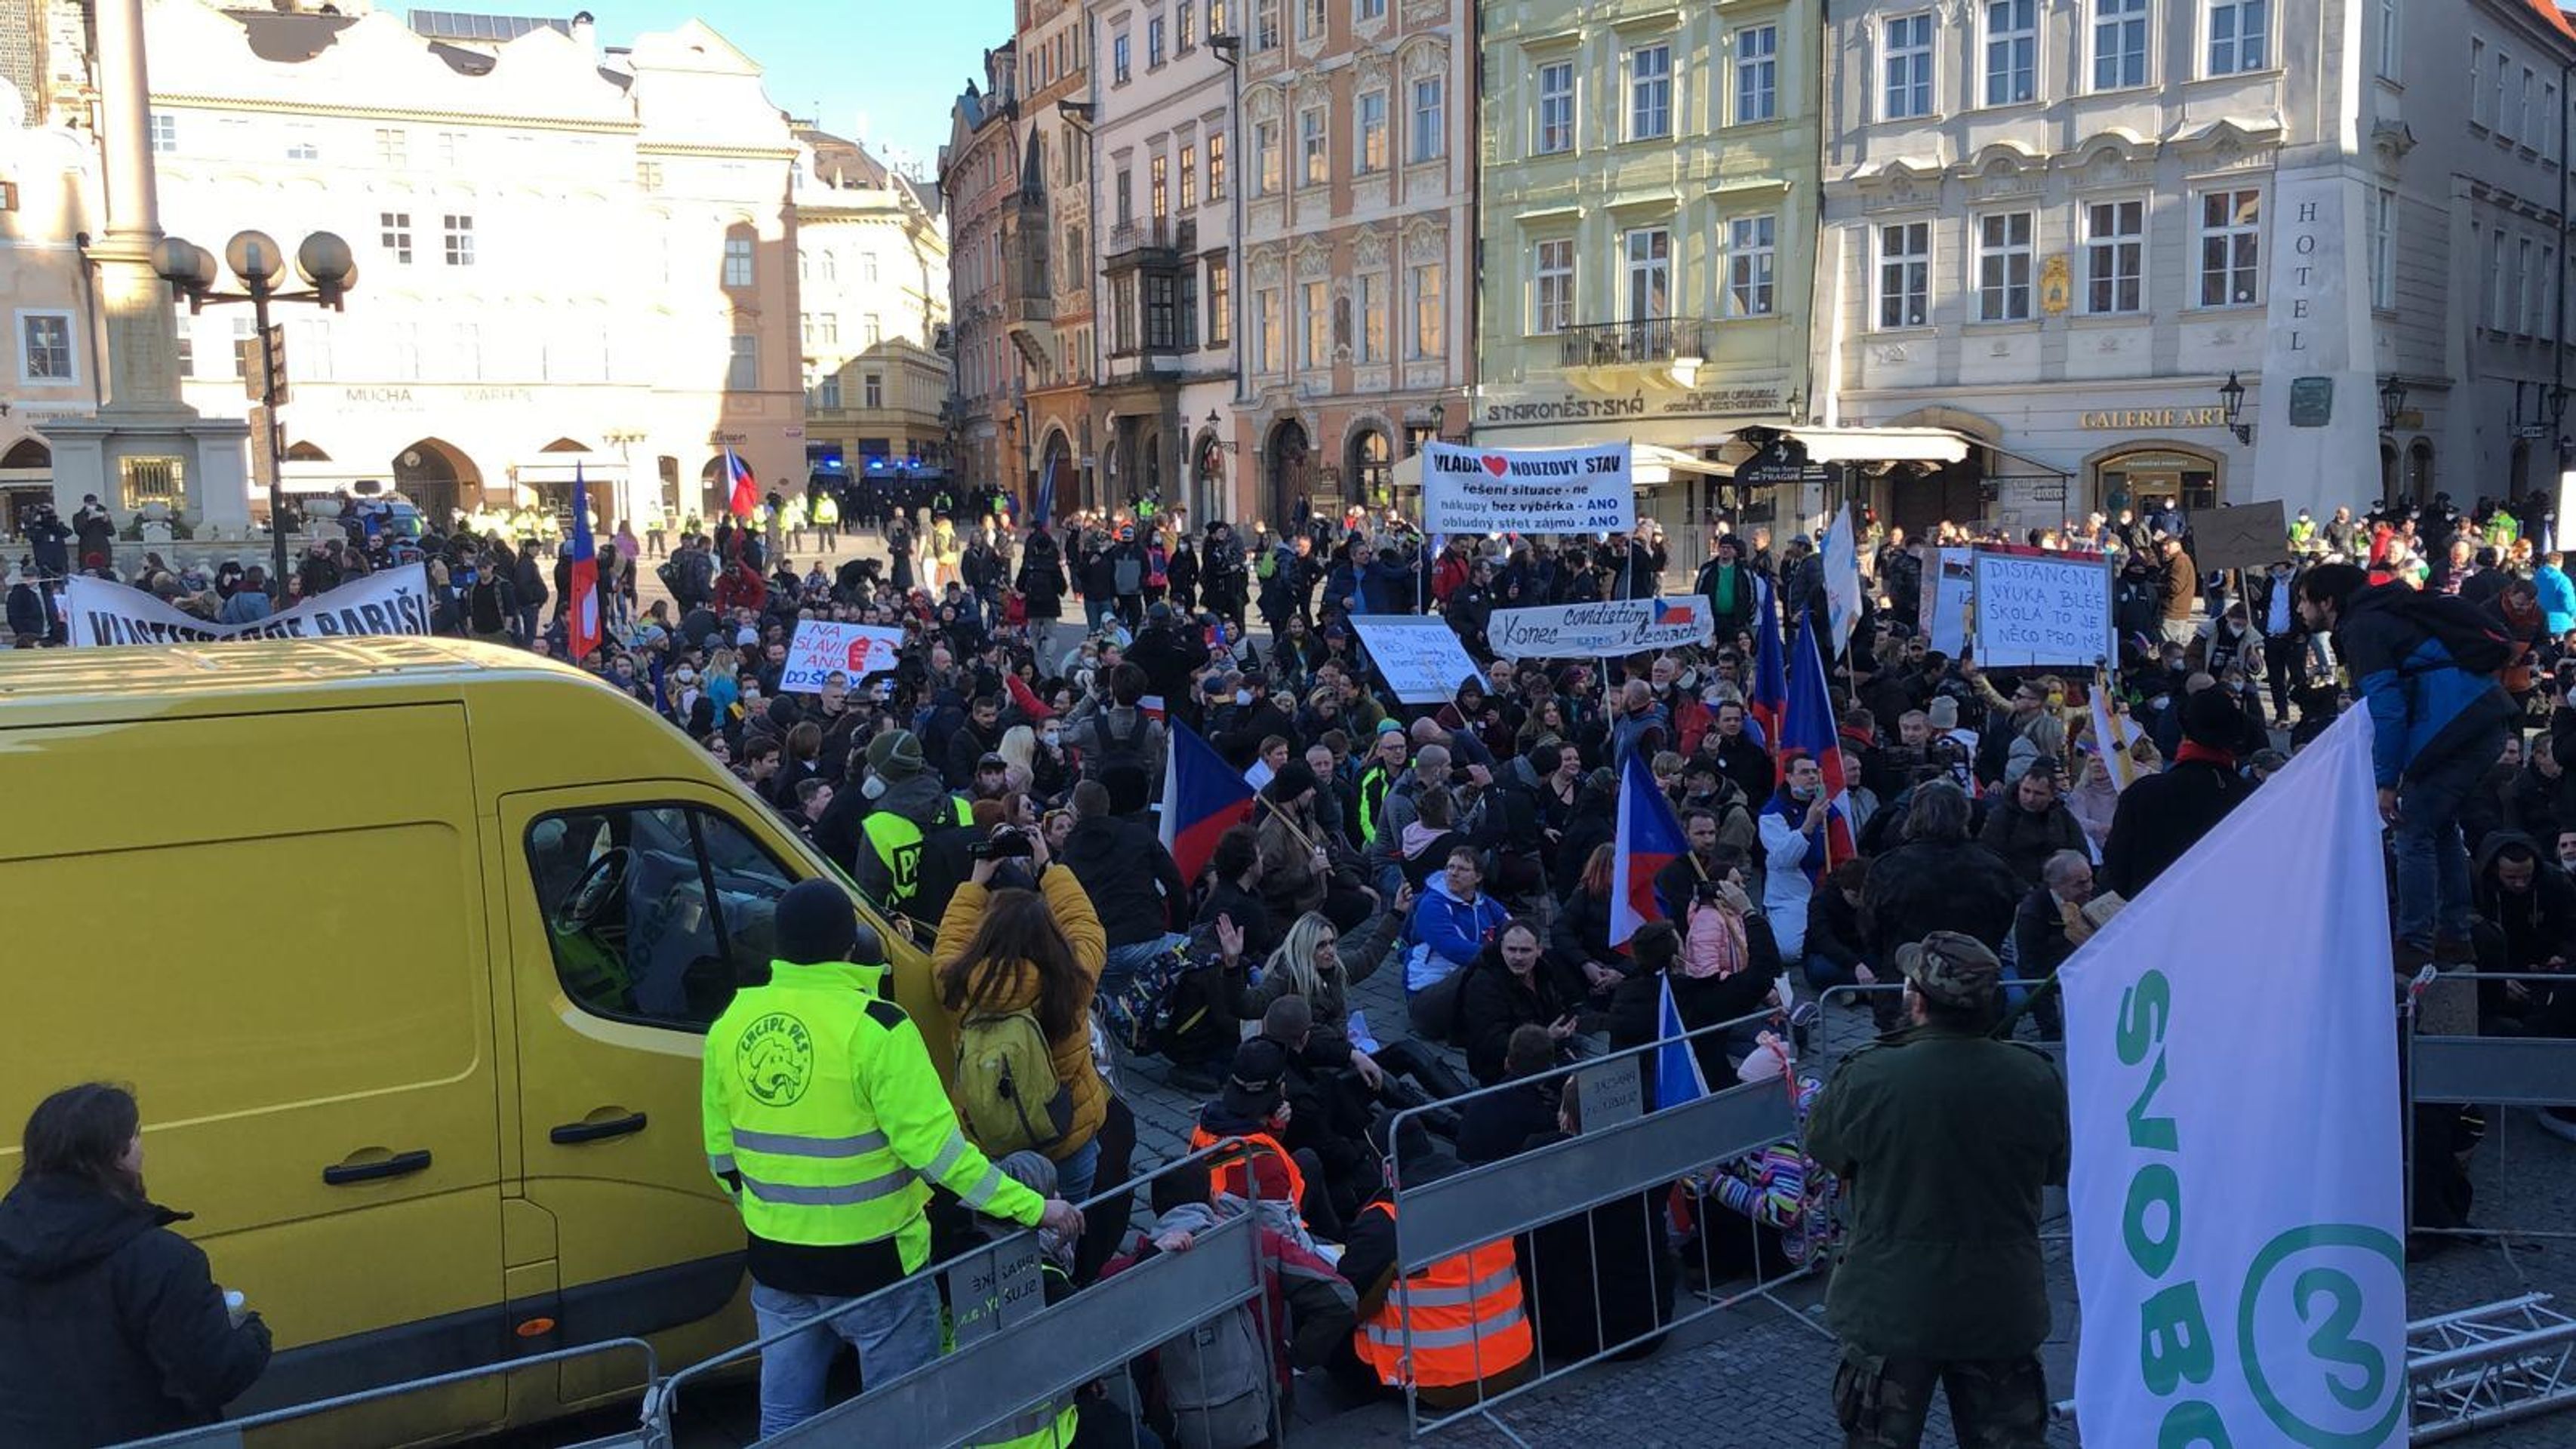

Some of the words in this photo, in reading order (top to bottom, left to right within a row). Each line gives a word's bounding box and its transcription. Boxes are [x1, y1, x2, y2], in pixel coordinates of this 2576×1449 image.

[2290, 202, 2316, 351] HOTEL
[346, 388, 412, 401] MUCHA
[2080, 410, 2173, 429] GALERIE
[2183, 408, 2227, 426] ART
[1434, 453, 1482, 473] VLÁDA
[1510, 457, 1578, 476] NOUZOVÝ
[1585, 454, 1621, 473] STAV
[1512, 484, 1562, 495] situace
[1573, 485, 1589, 495] ne
[1441, 499, 1488, 513] nákupy
[1492, 500, 1516, 512] bez
[1520, 499, 1574, 513] výběrka
[1587, 499, 1618, 510] ANO
[1442, 516, 1493, 529] obludný
[1588, 515, 1620, 527] ANO
[2049, 611, 2072, 625] TO
[809, 623, 840, 638] NA
[1503, 615, 1559, 647] Konec
[2046, 629, 2075, 646] PRO
[803, 654, 846, 669] ANO
[785, 671, 808, 684] DO
[787, 1023, 809, 1053] PES
